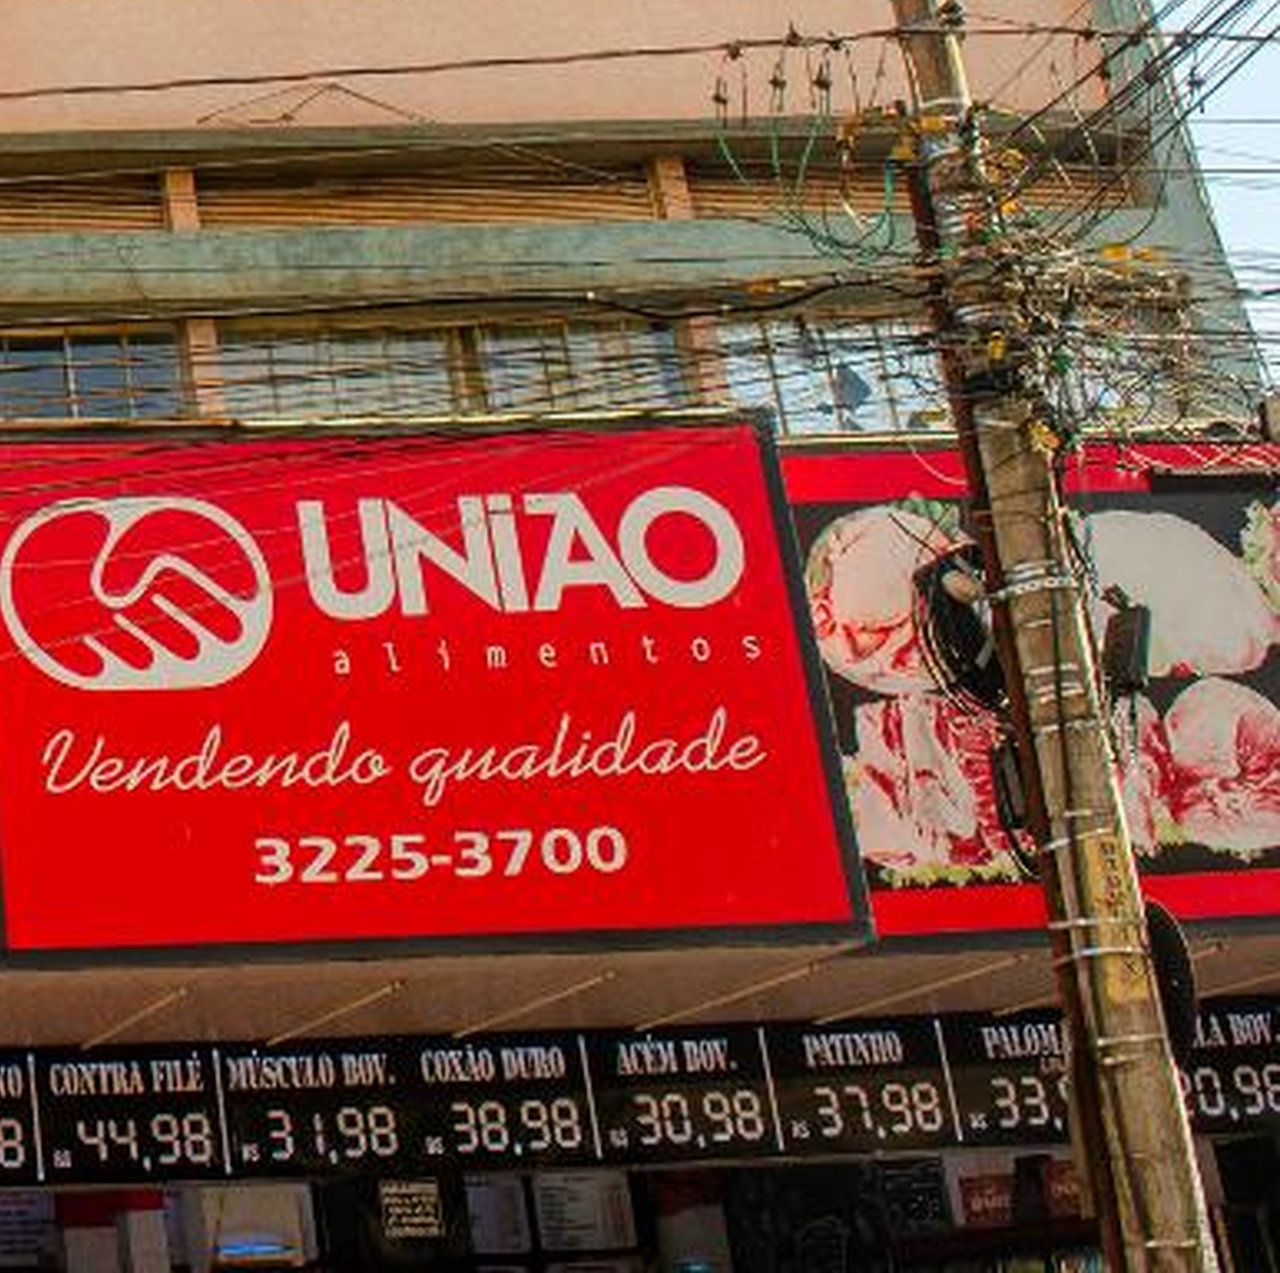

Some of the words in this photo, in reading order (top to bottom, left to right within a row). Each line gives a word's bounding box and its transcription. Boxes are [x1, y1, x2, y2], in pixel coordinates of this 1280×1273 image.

[334, 635, 762, 675] alimentos
[42, 721, 393, 794] Vendendo
[409, 705, 767, 806] qualidade
[254, 825, 628, 884] 3225-3700
[501, 1045, 567, 1080] DURO
[802, 1029, 905, 1068] PATINHO
[49, 1060, 145, 1096] CONTRA
[990, 1075, 1071, 1131] 33,
[266, 1106, 401, 1165] 31,98
[450, 1097, 583, 1156] 38,98
[633, 1089, 764, 1149] 30,98
[813, 1081, 943, 1139] 37,98
[76, 1112, 213, 1172] 44,98
